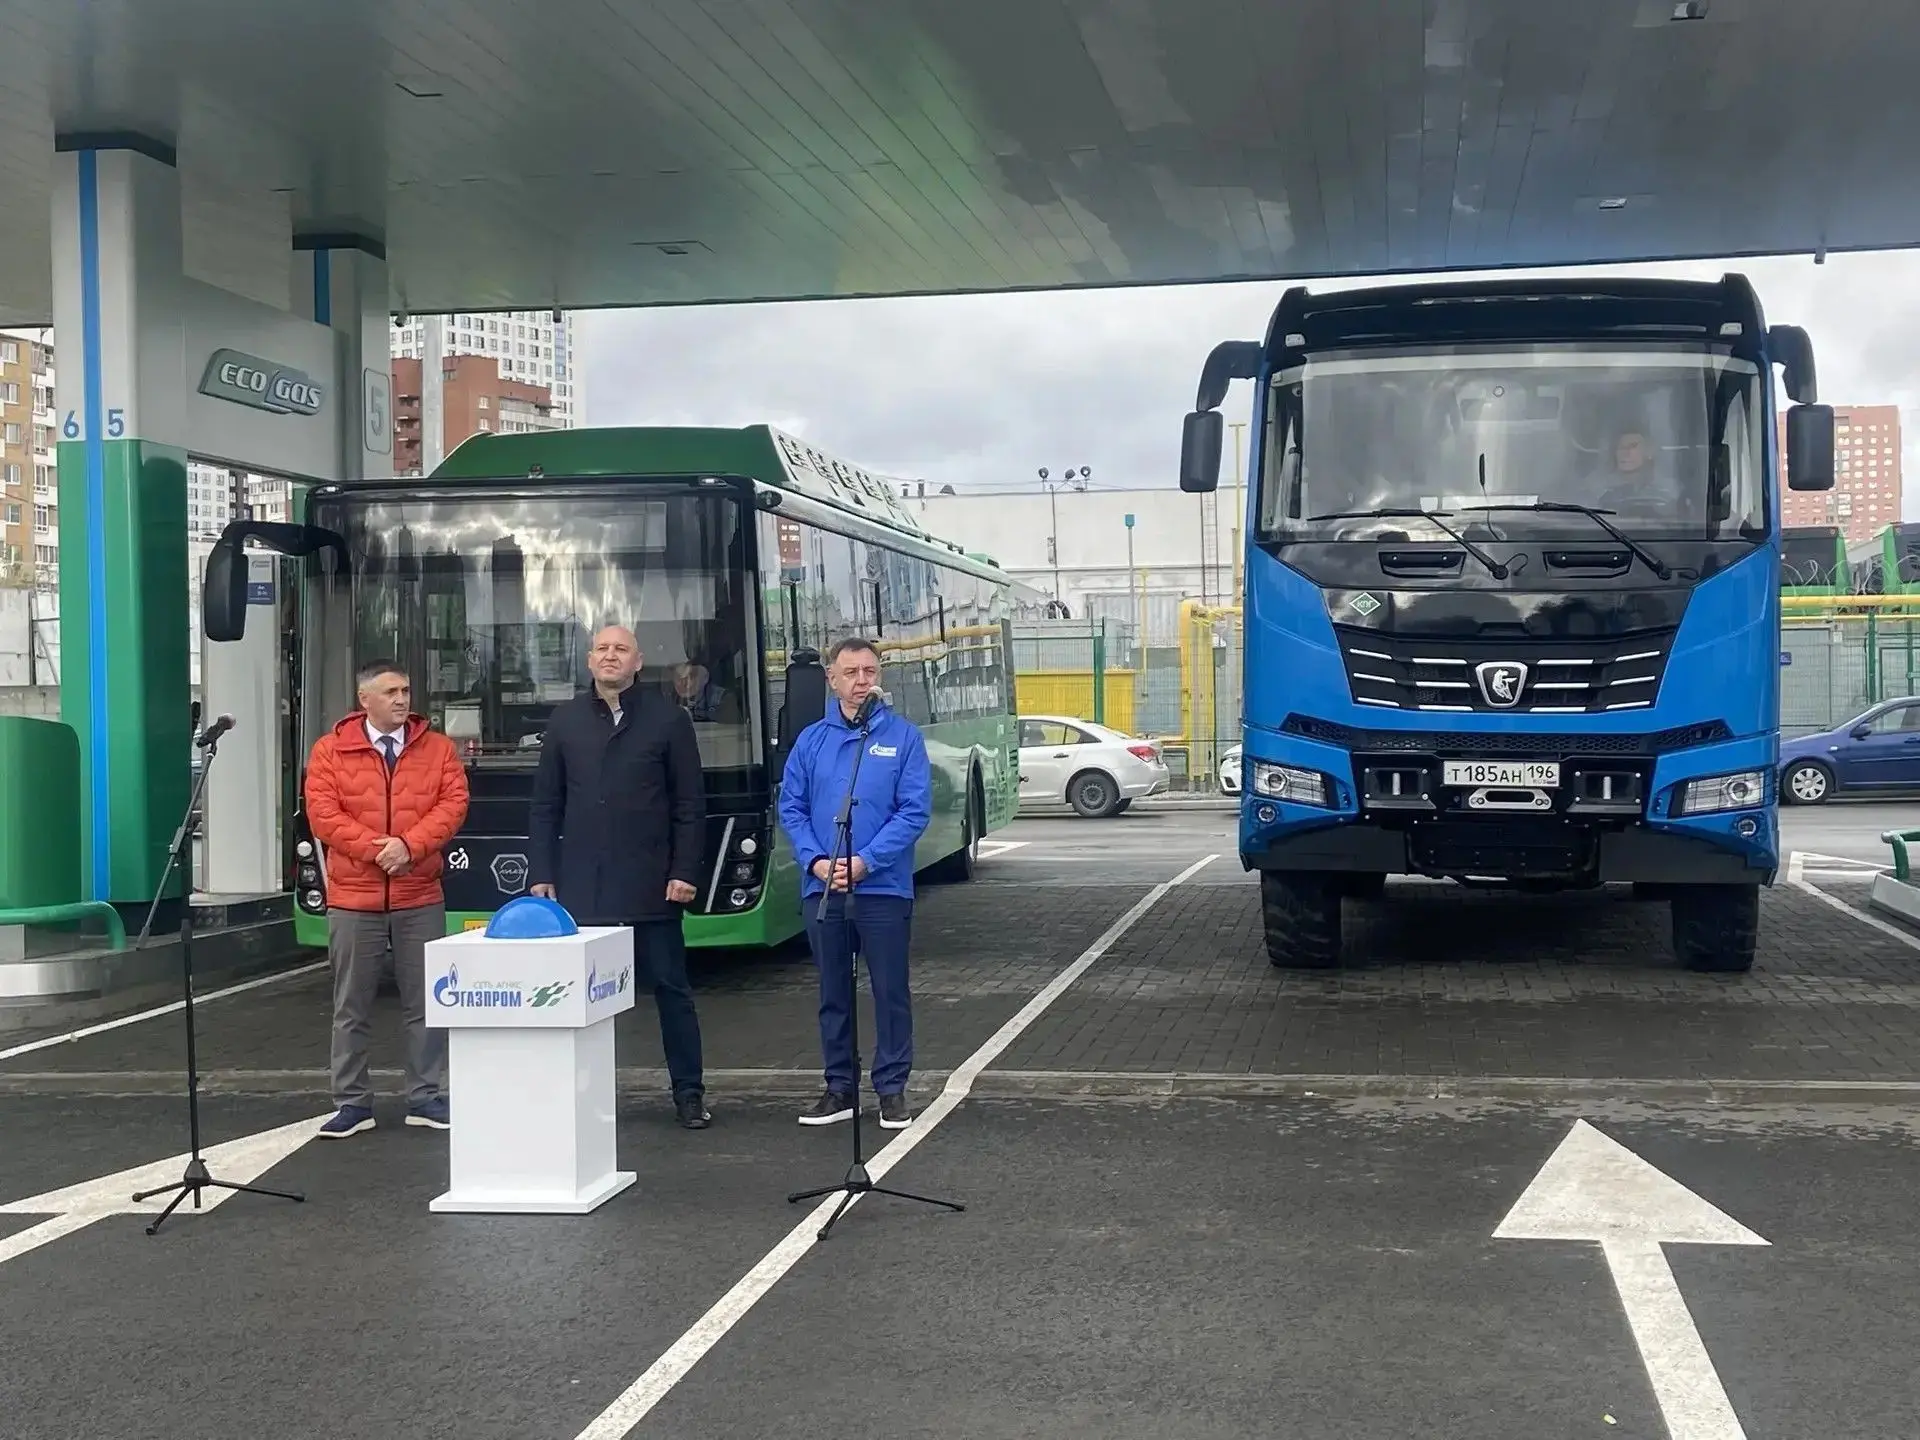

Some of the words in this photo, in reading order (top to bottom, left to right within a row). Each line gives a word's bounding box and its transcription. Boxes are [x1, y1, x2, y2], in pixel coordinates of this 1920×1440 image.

[220, 363, 268, 392] ECO
[63, 409, 80, 439] 6
[107, 408, 125, 437] 5
[370, 385, 385, 437] 5
[1526, 765, 1555, 779] 196
[459, 990, 522, 1008] ГАЗПРОМ
